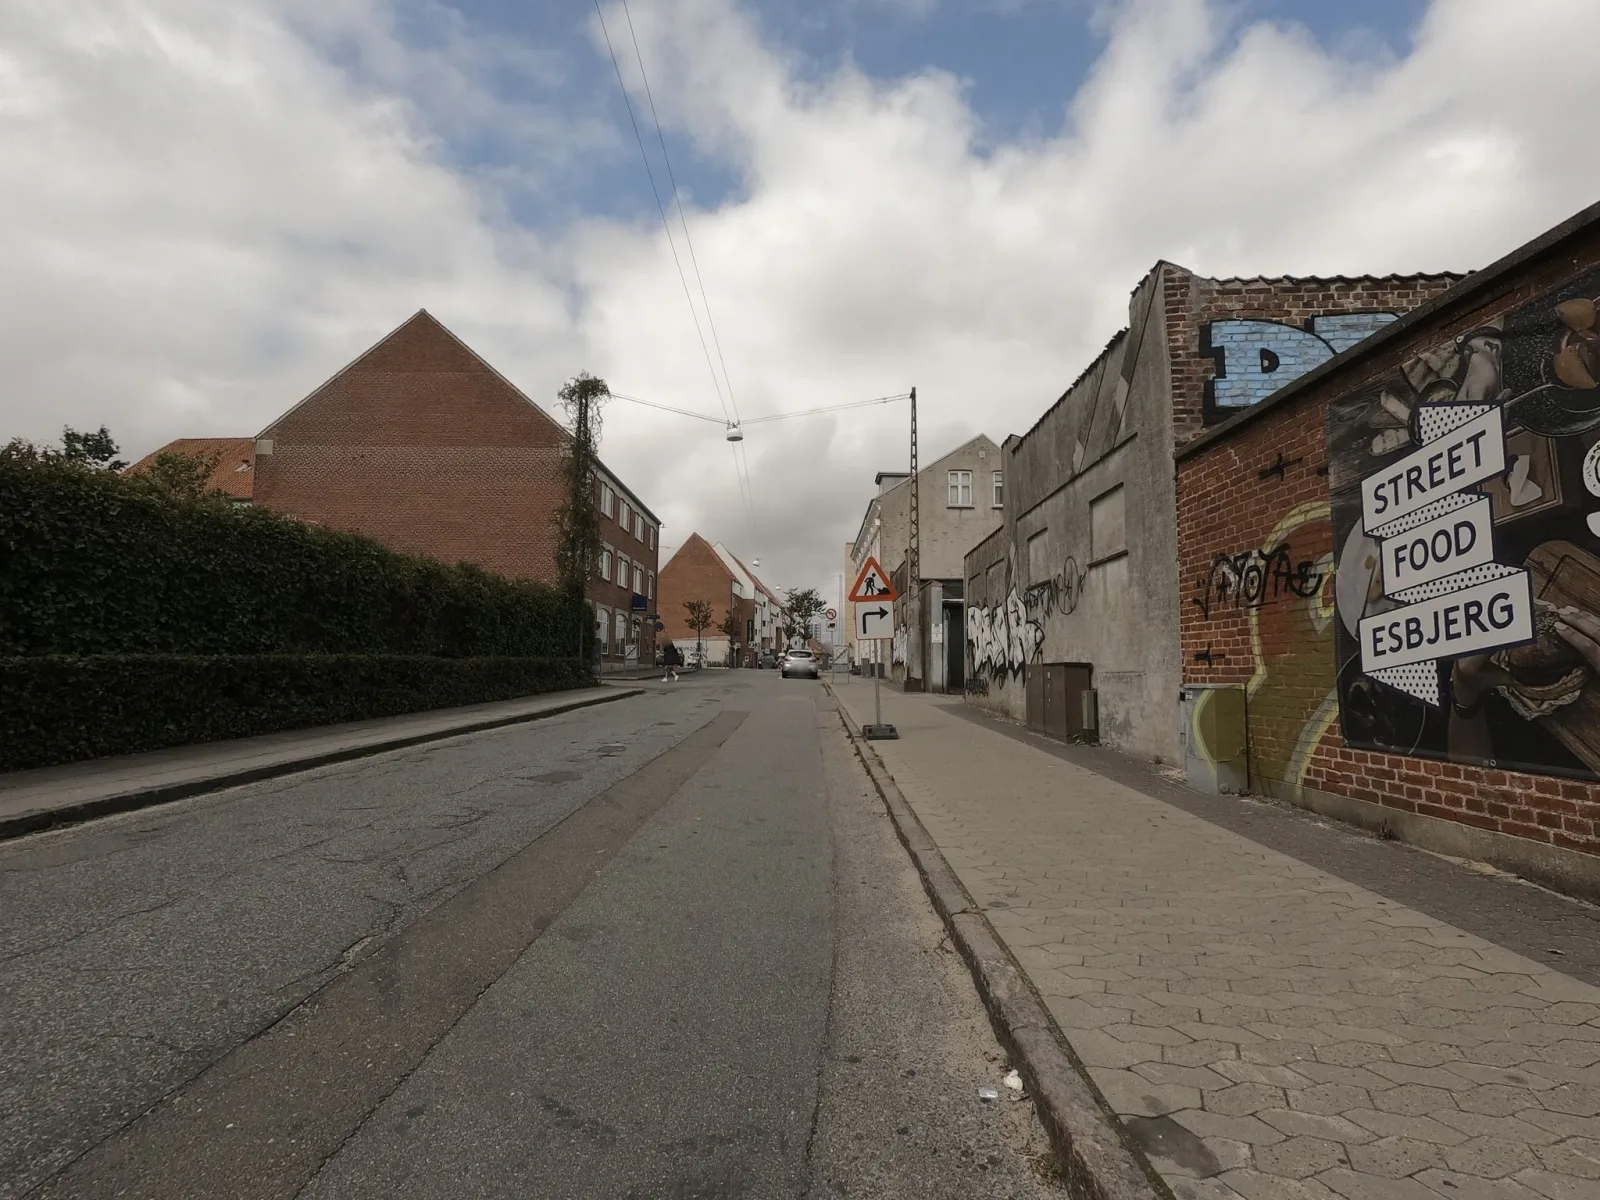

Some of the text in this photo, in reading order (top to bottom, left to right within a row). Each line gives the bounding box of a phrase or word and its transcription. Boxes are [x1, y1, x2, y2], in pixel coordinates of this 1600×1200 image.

[1374, 429, 1486, 514] STREET
[1394, 520, 1476, 578] FOOD
[1372, 592, 1514, 657] ESBJERG
